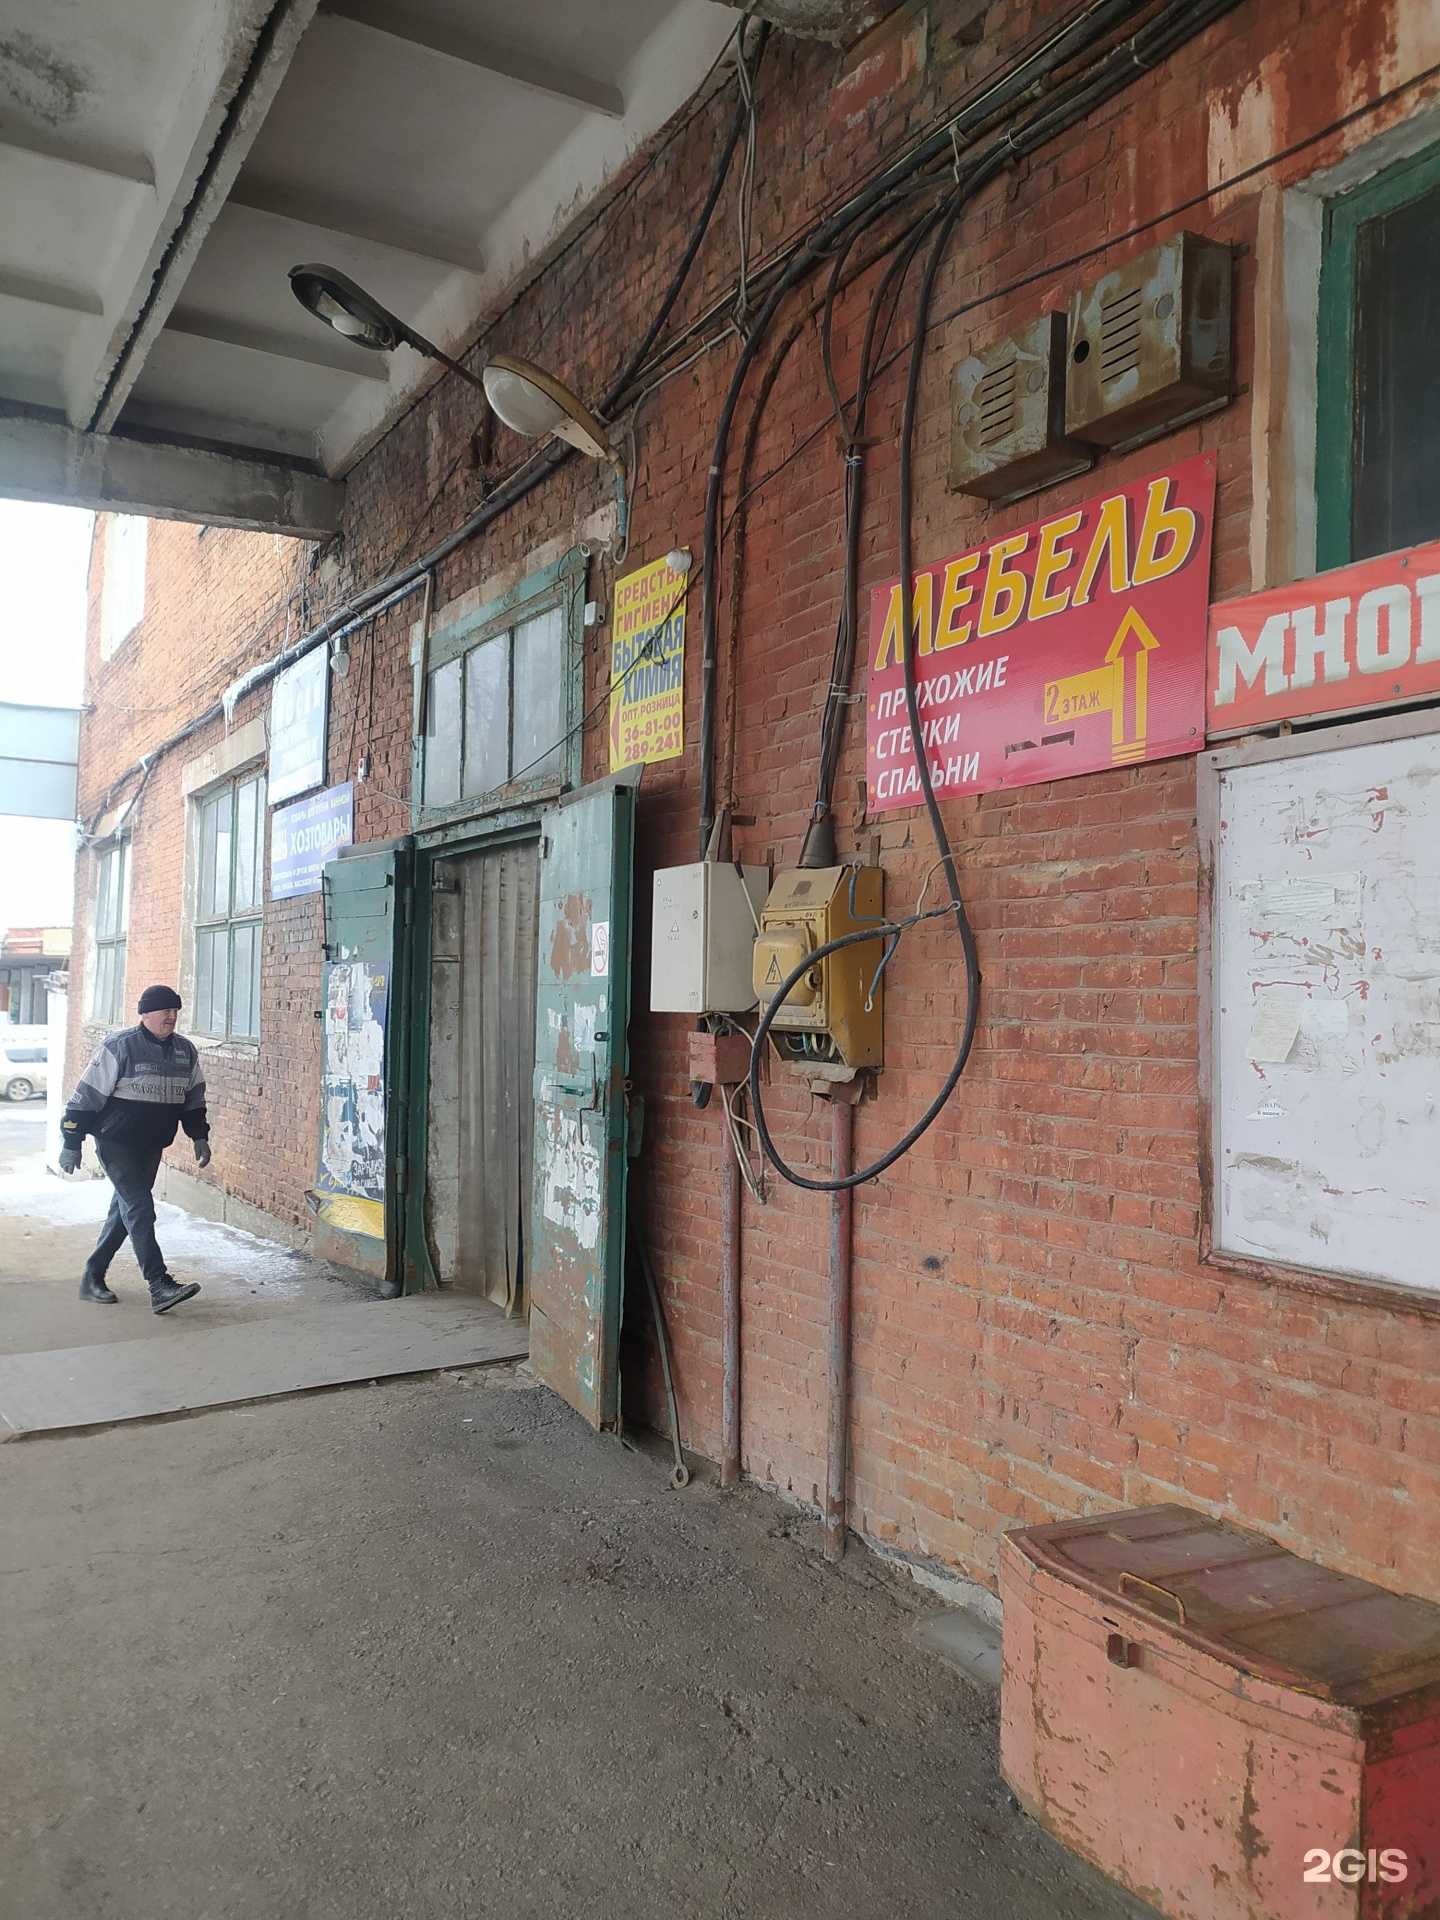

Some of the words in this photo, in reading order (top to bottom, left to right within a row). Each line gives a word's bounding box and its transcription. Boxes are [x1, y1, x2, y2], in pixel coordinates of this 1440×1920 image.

[874, 476, 1196, 671] МЕБЕЛЬ
[622, 653, 682, 706] ХИМИЯ
[1046, 684, 1060, 723] 2
